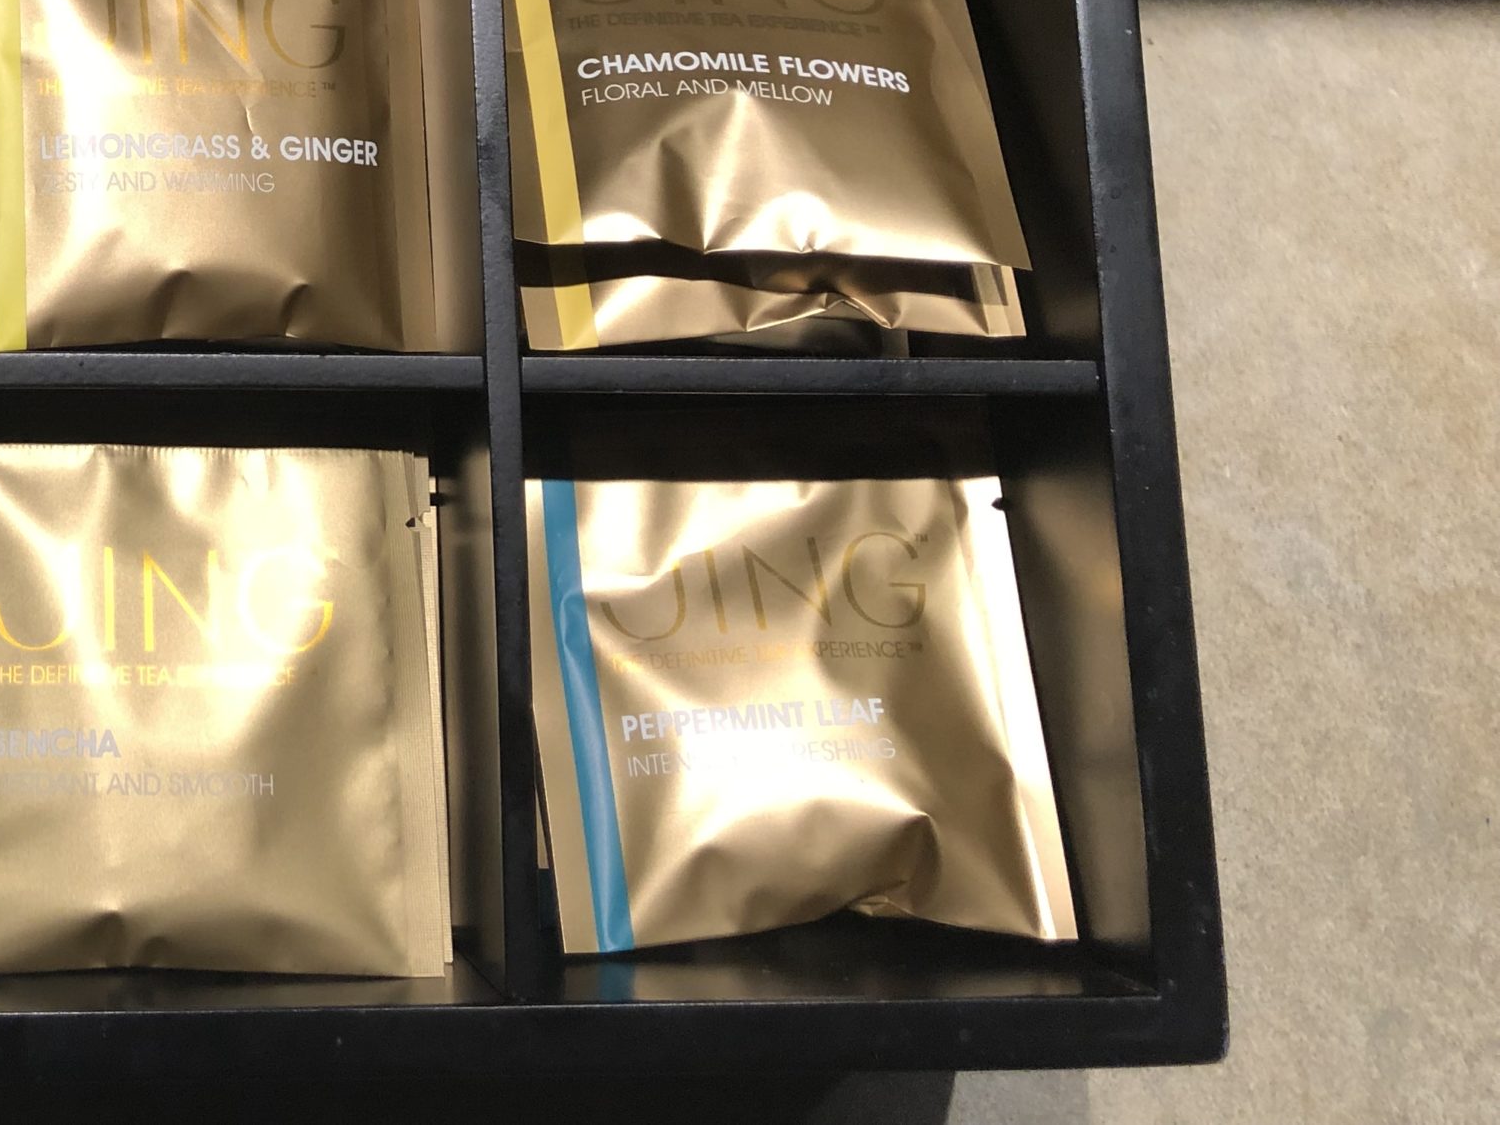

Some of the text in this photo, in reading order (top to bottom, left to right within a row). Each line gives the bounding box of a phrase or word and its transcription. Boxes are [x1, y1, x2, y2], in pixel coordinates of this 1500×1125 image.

[576, 50, 912, 95] CHAMOMILE FLOWERS
[580, 77, 835, 108] FLORAL AND MELLOW
[38, 132, 379, 168] LEMONGRASS & GINGER
[104, 170, 157, 193] AND
[163, 171, 277, 194] WARMING
[601, 530, 927, 642] JING
[649, 646, 749, 671] DEFINITIVE
[800, 639, 906, 661] XPERIENCE
[137, 664, 174, 686] TEA
[620, 697, 885, 743] PEPPERMINT LEAF
[106, 771, 162, 796] AND
[168, 771, 275, 797] SMOOTH
